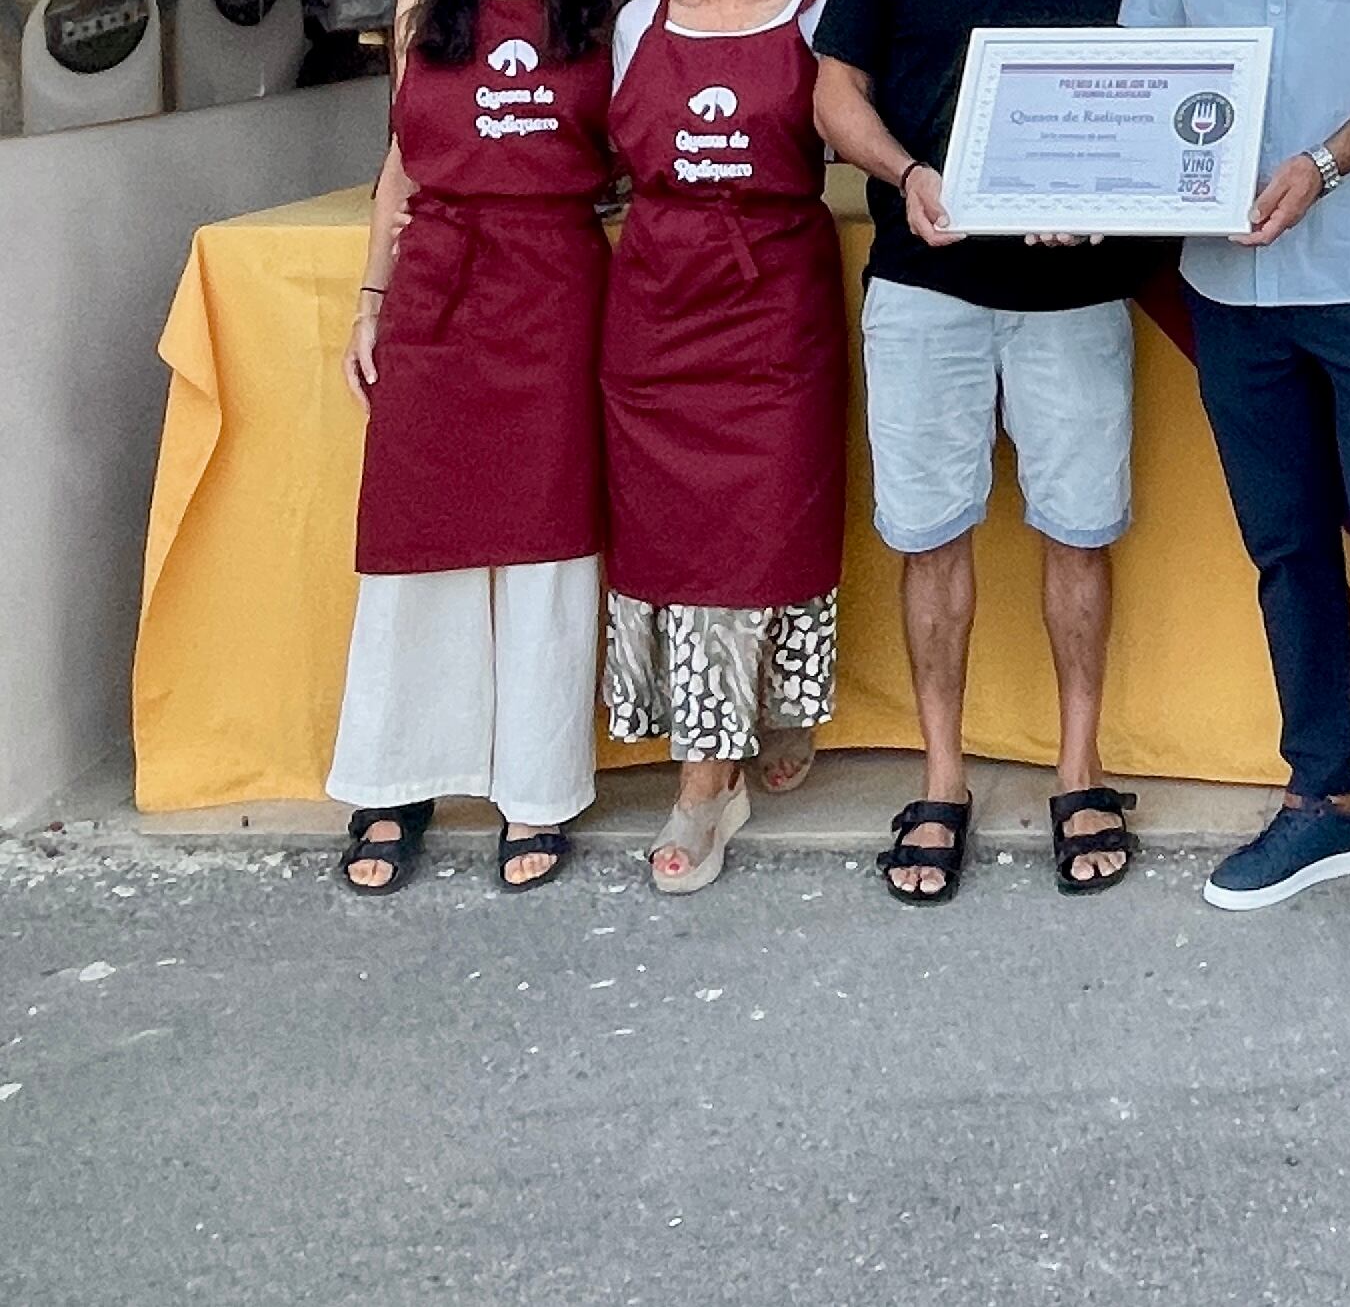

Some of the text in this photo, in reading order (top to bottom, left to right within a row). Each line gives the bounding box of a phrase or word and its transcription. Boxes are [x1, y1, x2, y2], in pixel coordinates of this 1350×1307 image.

[1010, 109, 1155, 126] Quesos de Radiquero
[1183, 158, 1215, 173] VINO
[1178, 179, 1211, 195] 2025
